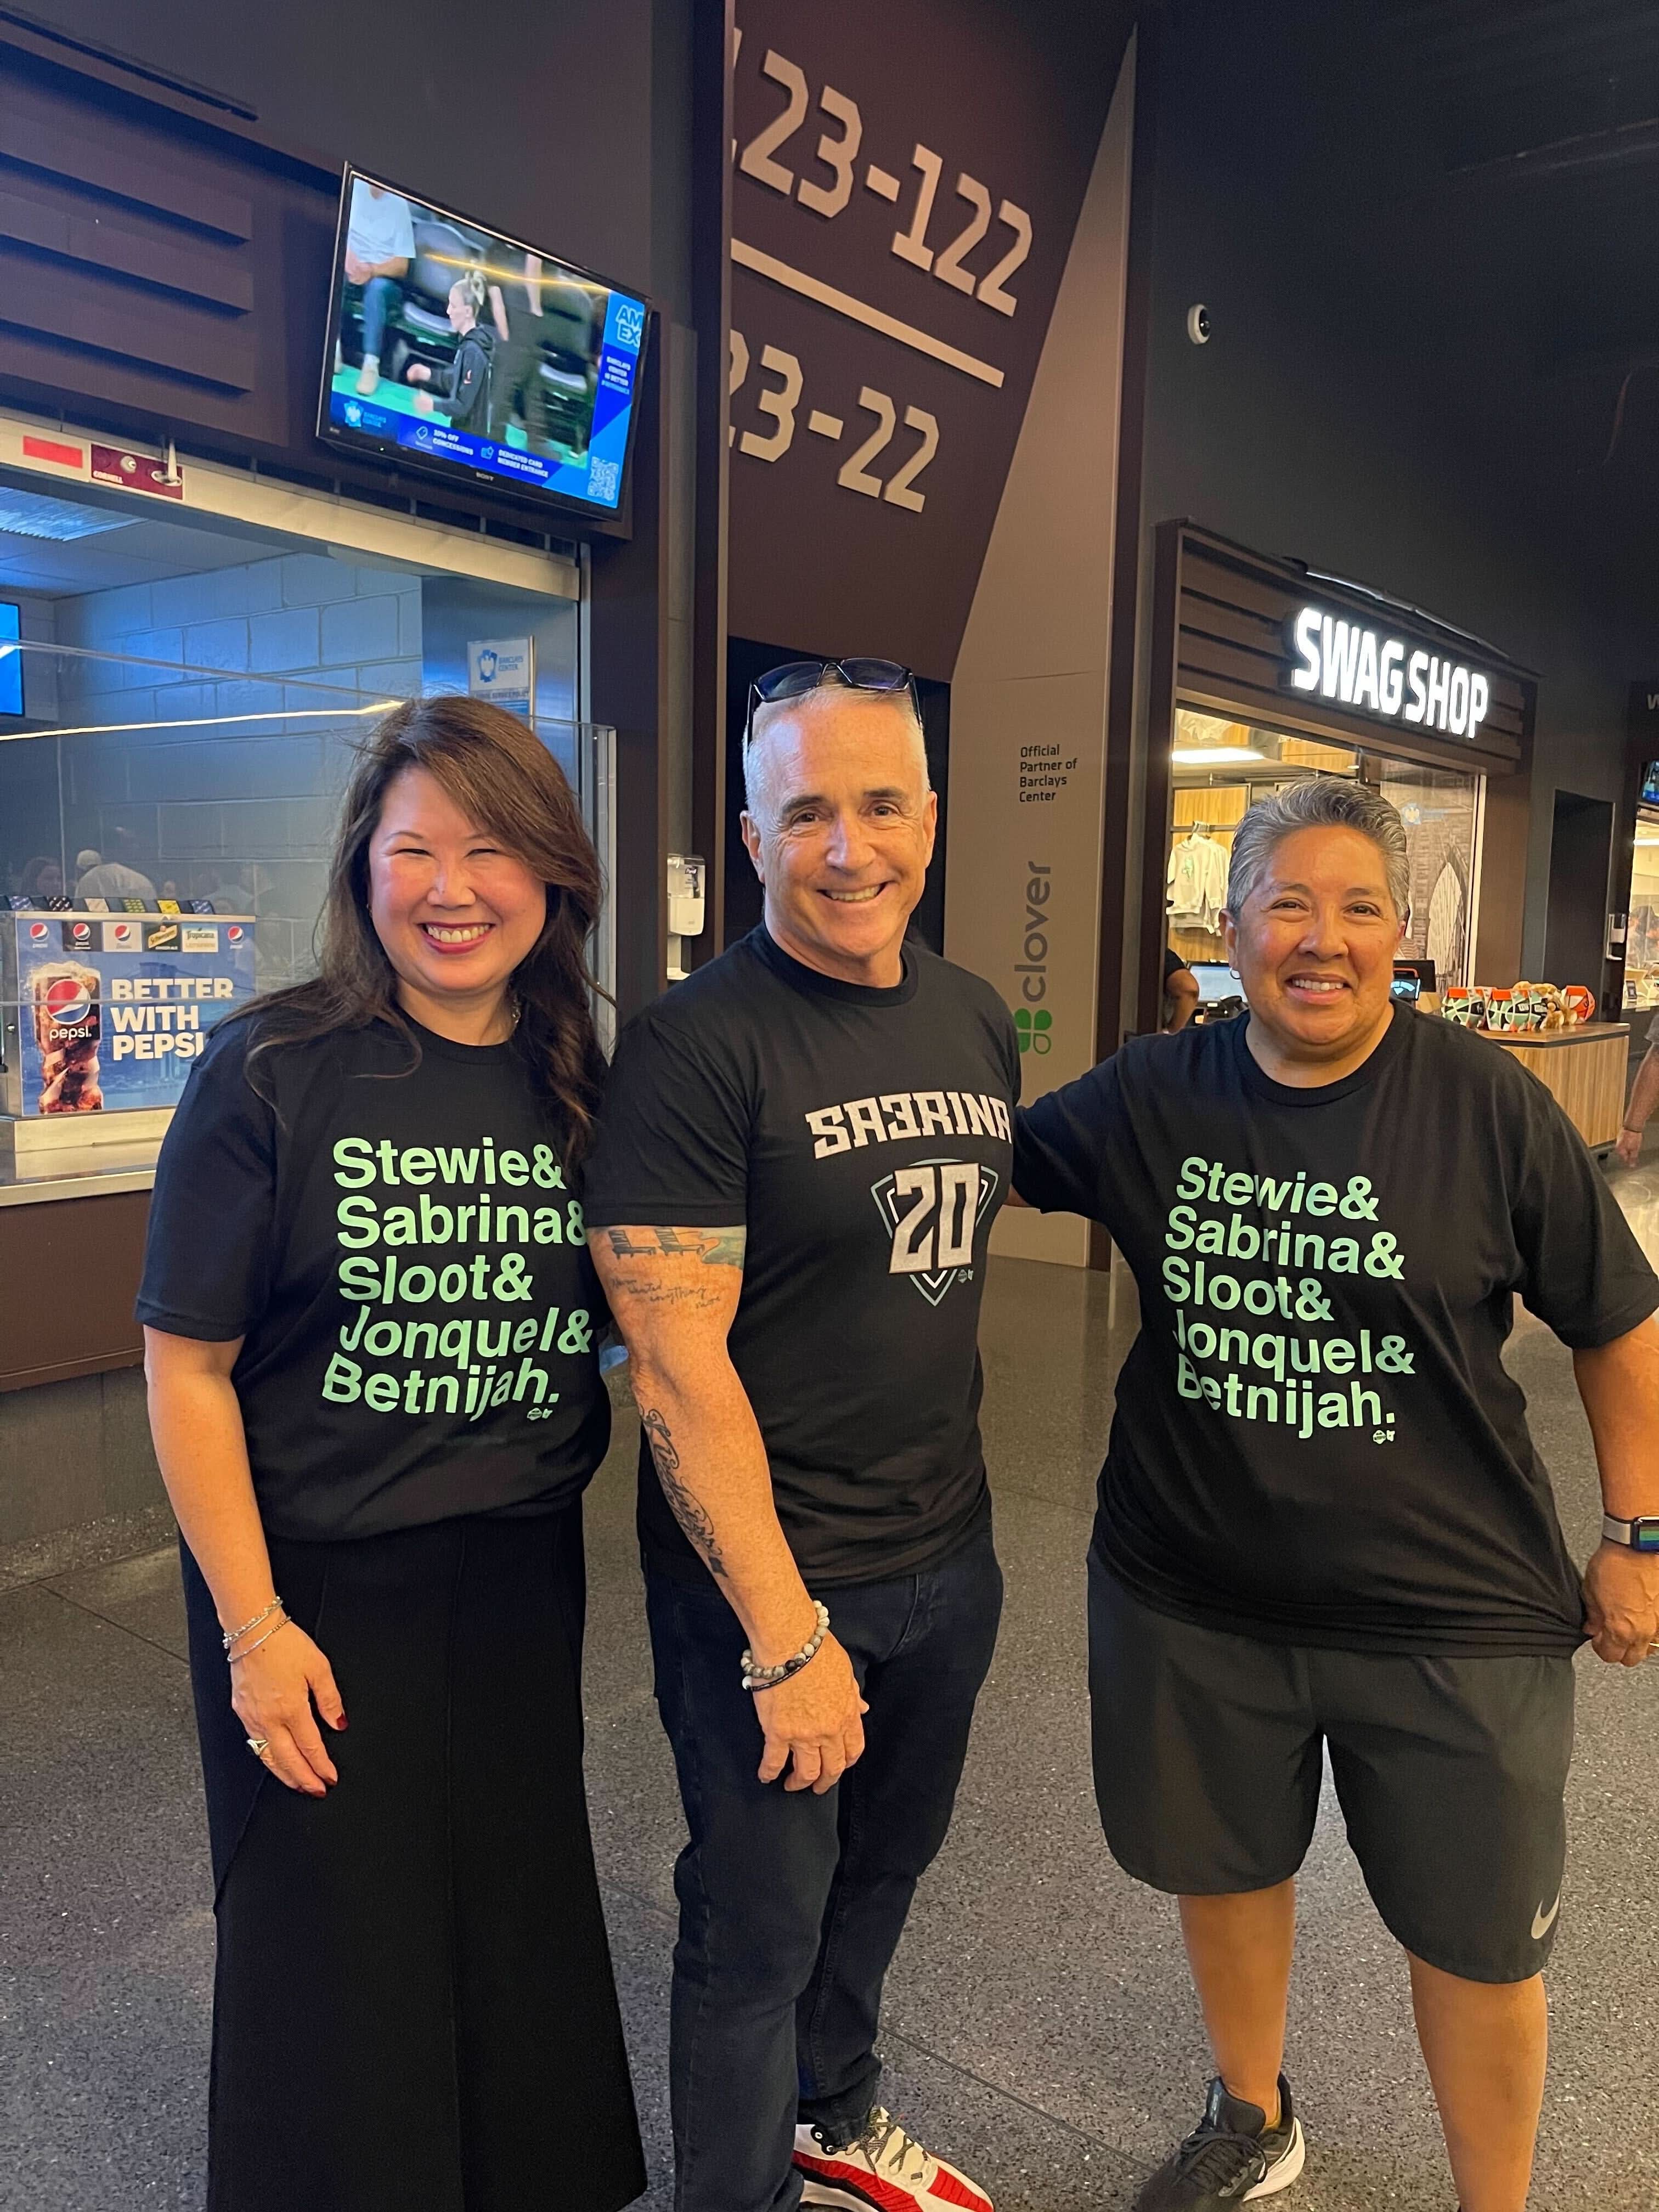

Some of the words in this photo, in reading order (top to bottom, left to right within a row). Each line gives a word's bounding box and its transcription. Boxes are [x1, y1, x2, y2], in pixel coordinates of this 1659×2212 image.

[732, 27, 1032, 317] 23-122
[1292, 607, 1404, 715] SWAG
[1403, 650, 1489, 739] SHOP
[1020, 744, 1060, 758] Official
[1020, 761, 1062, 772] Partner
[1065, 758, 1078, 769] of
[1019, 775, 1066, 788] Barclays
[1019, 791, 1056, 802] Center
[1014, 861, 1051, 1002] clover
[111, 978, 234, 1000] BETTER
[49, 1026, 91, 1041] pepsi
[110, 1005, 199, 1032] WITH
[113, 1032, 205, 1060] PEPSI
[333, 1137, 567, 1189] Stewie&
[1176, 1156, 1380, 1222] Stewie&
[337, 1193, 587, 1249] Sabrina&
[889, 1163, 979, 1274] 20
[1165, 1205, 1405, 1280] Sabrina&
[338, 1252, 534, 1304] Sloot&
[1161, 1256, 1334, 1321] Sloot&
[339, 1304, 593, 1370] Jonquel&
[321, 1351, 560, 1422] Betnijah.
[1177, 1353, 1396, 1439] Betnijah.
